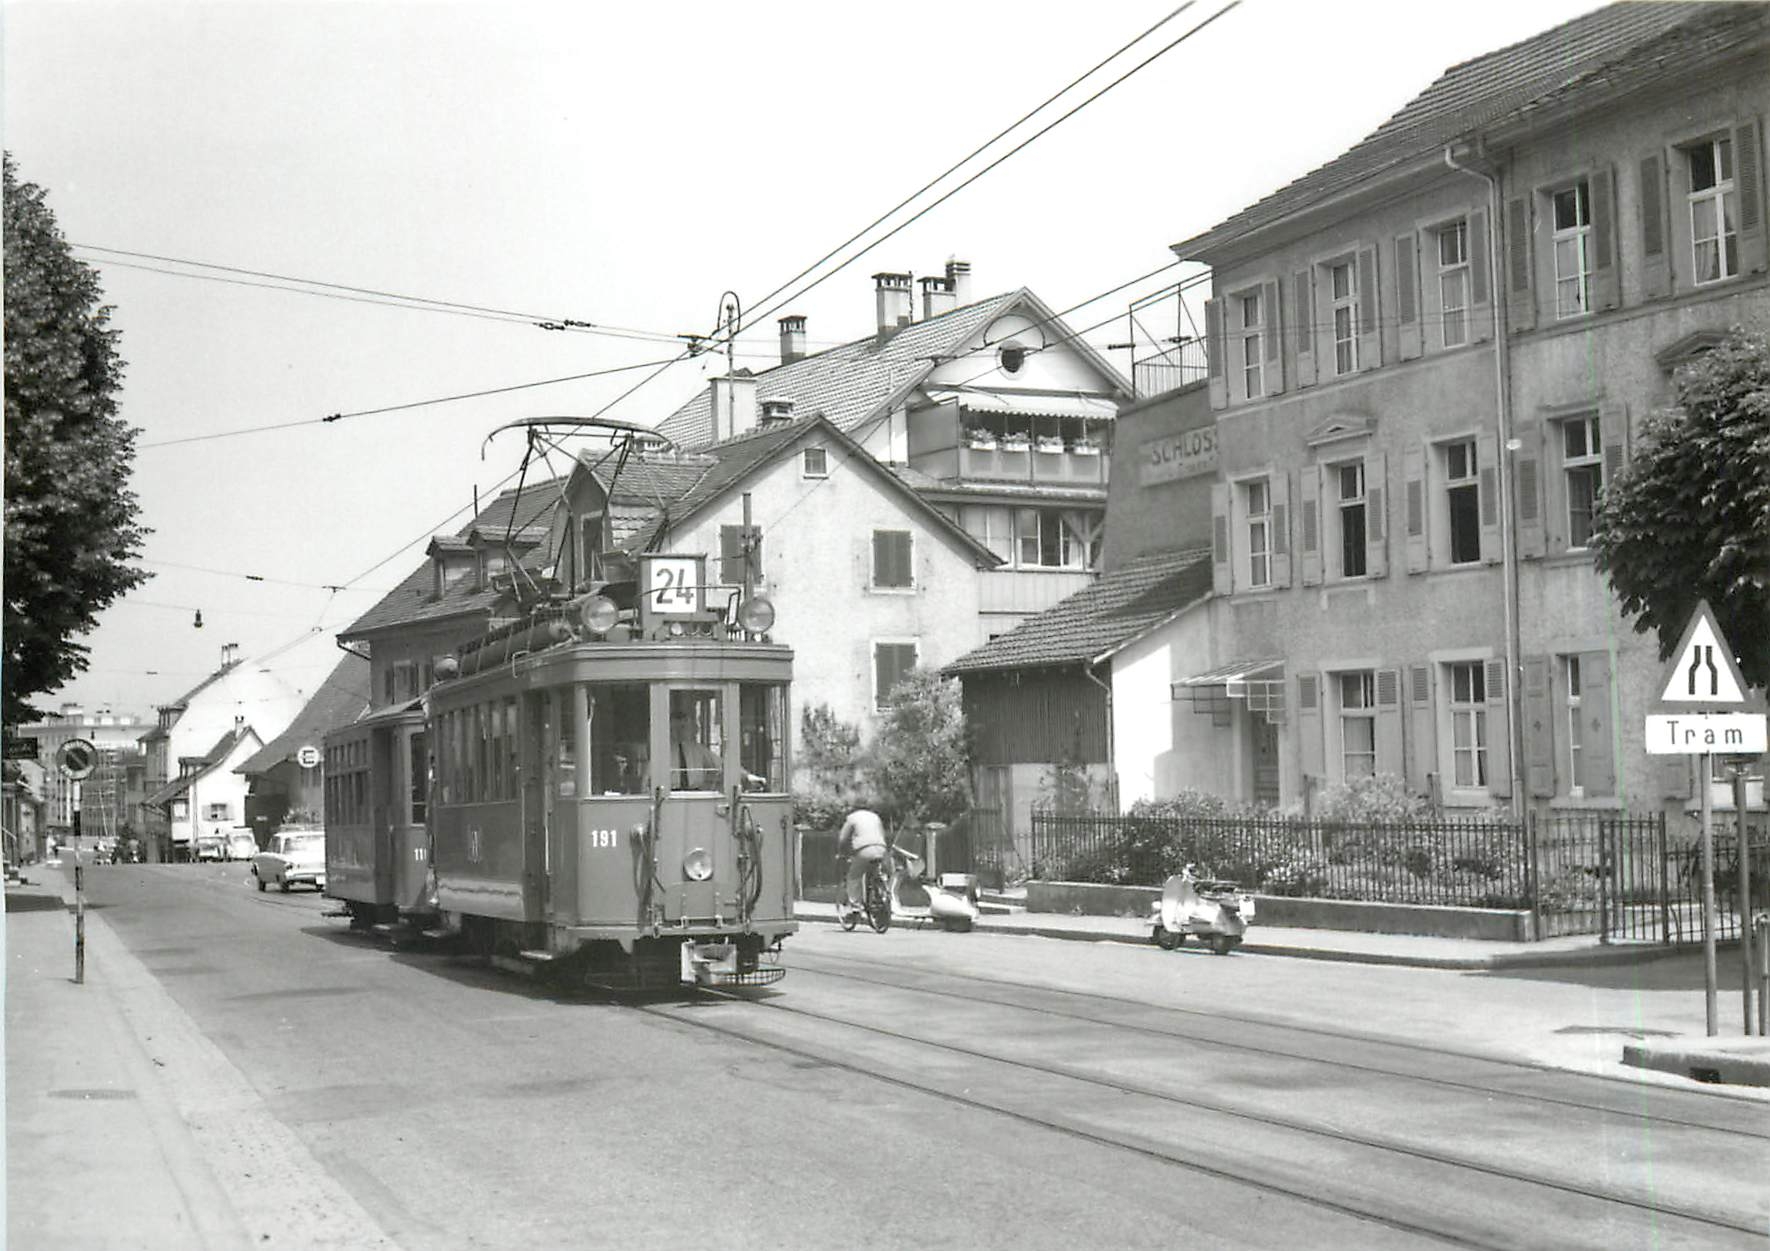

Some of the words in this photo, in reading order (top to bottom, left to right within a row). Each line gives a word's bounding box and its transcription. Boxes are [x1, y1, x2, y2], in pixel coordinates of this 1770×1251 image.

[1152, 430, 1217, 466] SCHLOS
[656, 568, 694, 605] 24
[1667, 721, 1743, 745] Tram
[591, 830, 618, 848] 191
